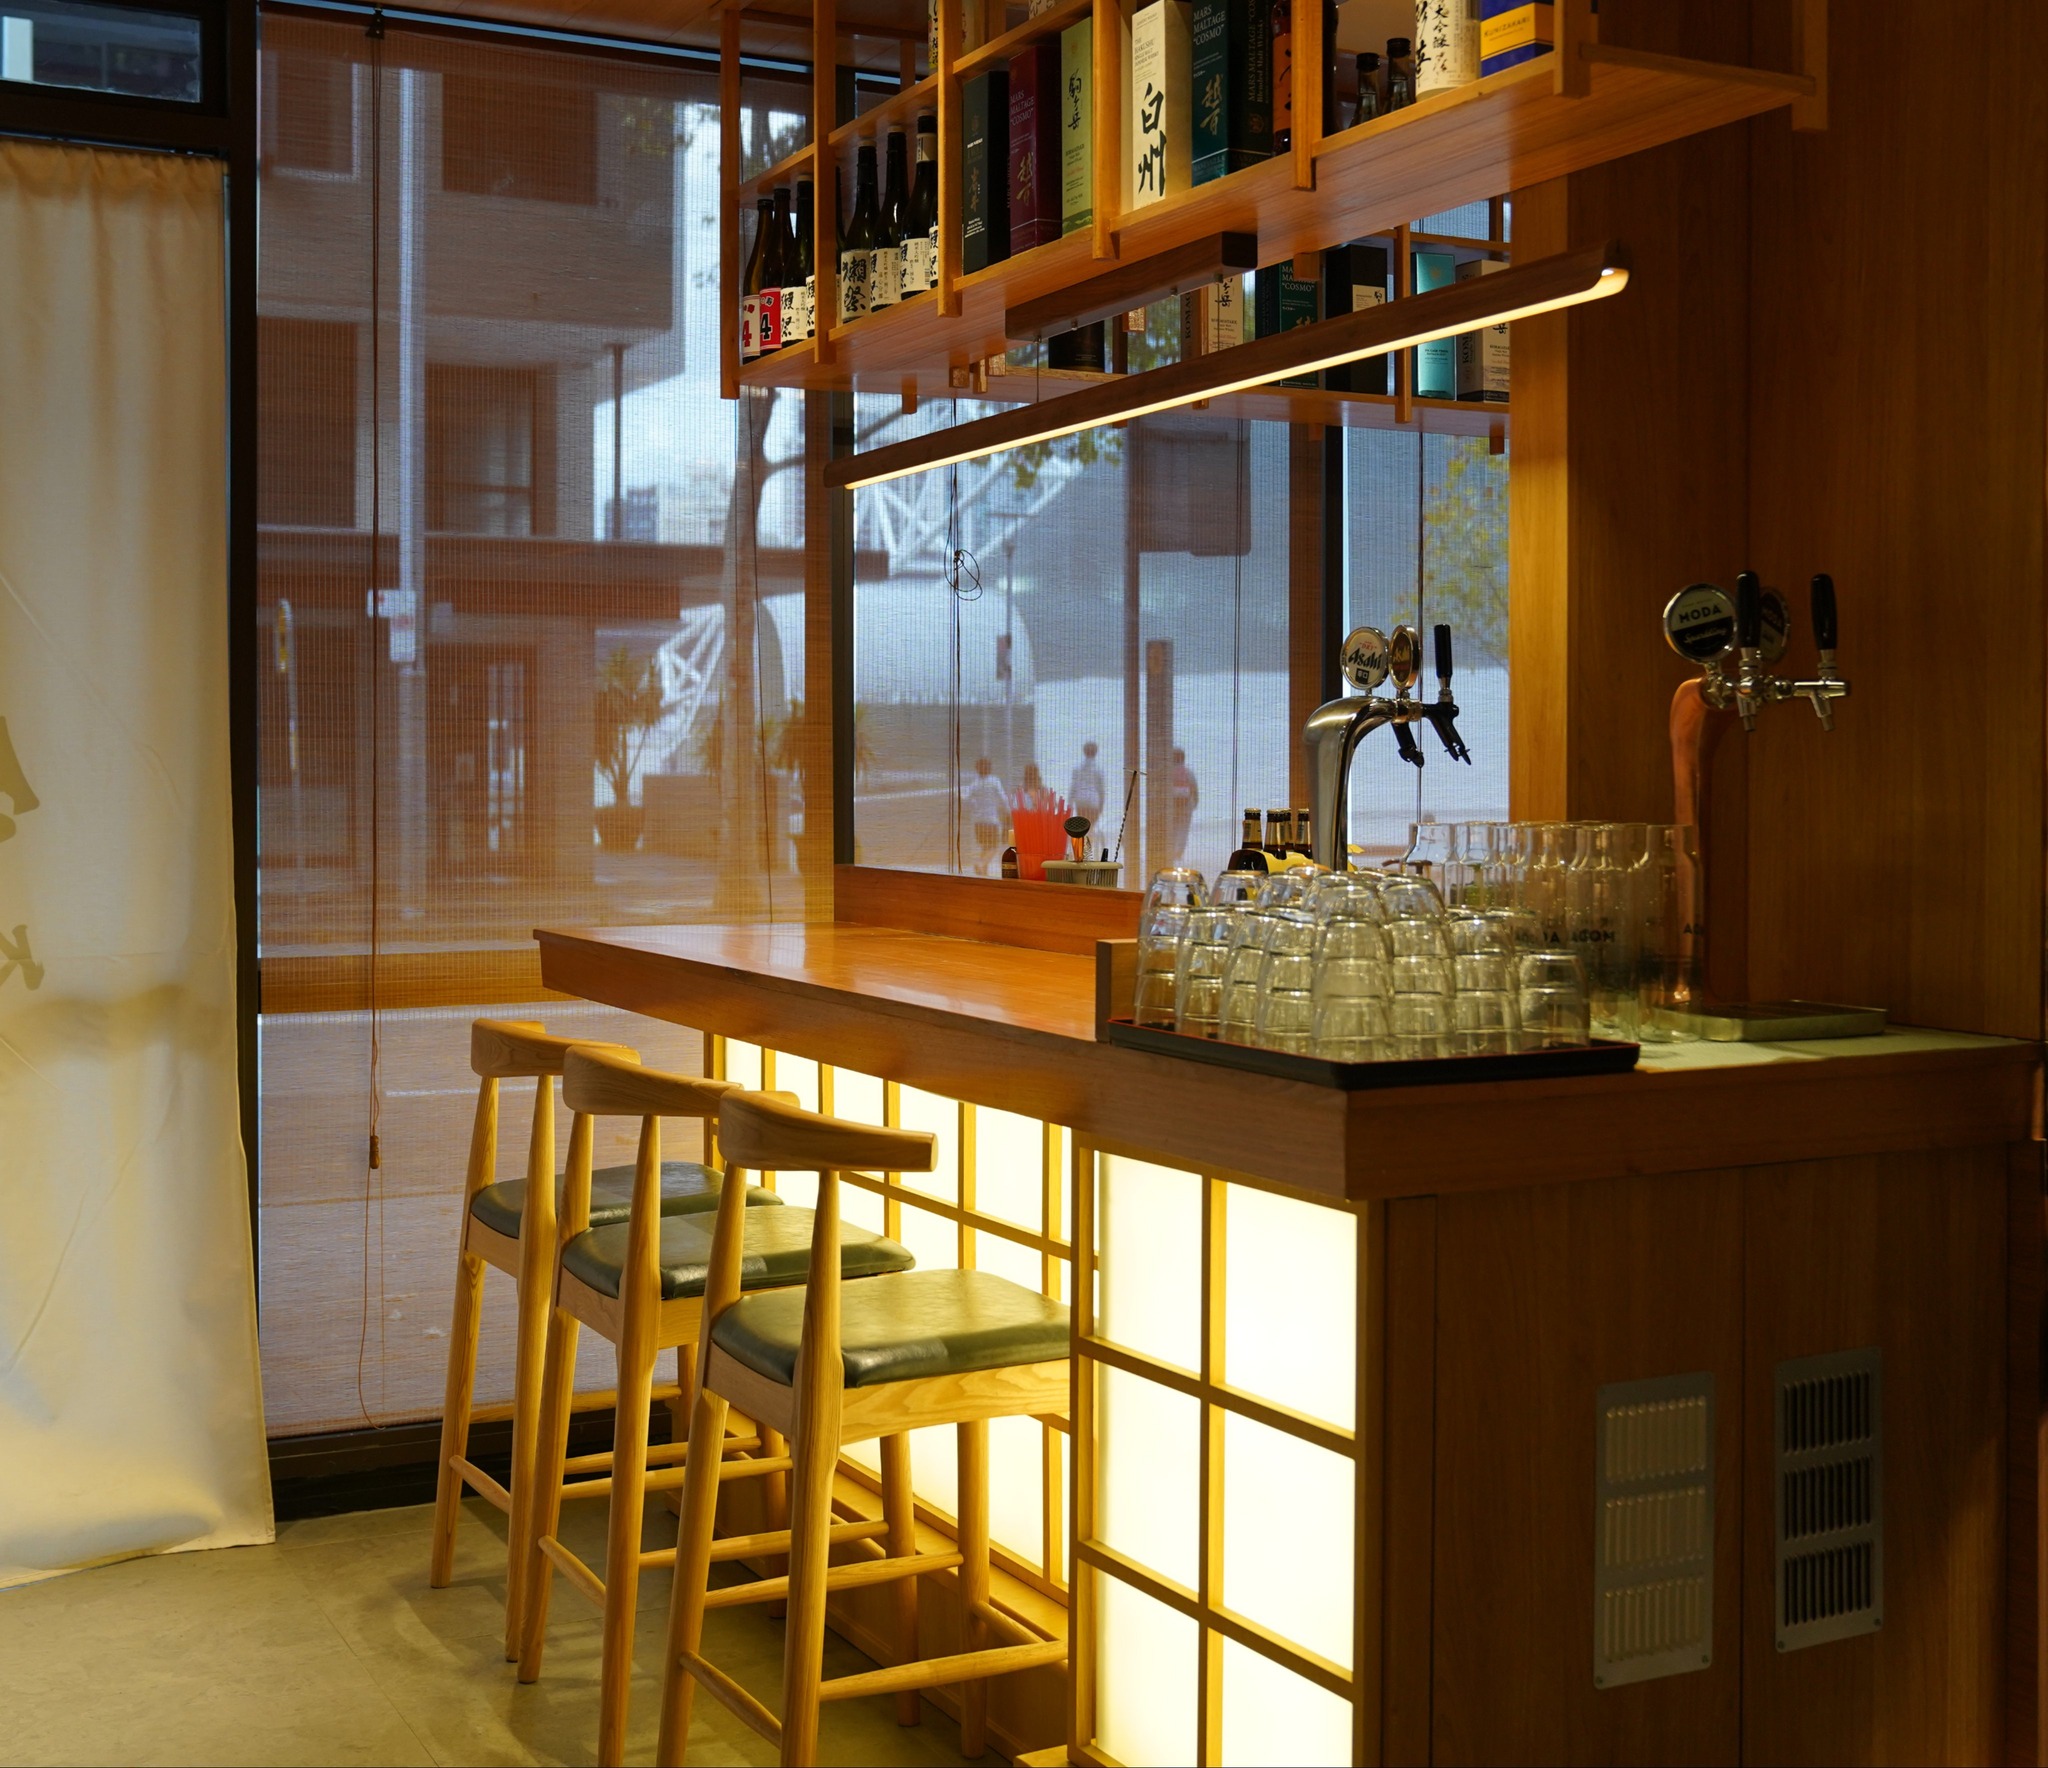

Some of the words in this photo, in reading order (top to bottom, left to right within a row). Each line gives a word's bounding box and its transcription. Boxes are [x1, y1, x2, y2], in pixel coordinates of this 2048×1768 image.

[1193, 4, 1212, 22] MARS
[1193, 10, 1227, 35] MALTAGE
[1193, 24, 1225, 46] "COSMO"
[1138, 82, 1167, 197] 白州
[842, 256, 867, 313] 獺祭
[1282, 282, 1315, 293] "COSMO"
[743, 320, 752, 347] 4
[760, 312, 772, 341] 4
[1678, 604, 1722, 624] MODA
[1348, 648, 1382, 670] Asahi
